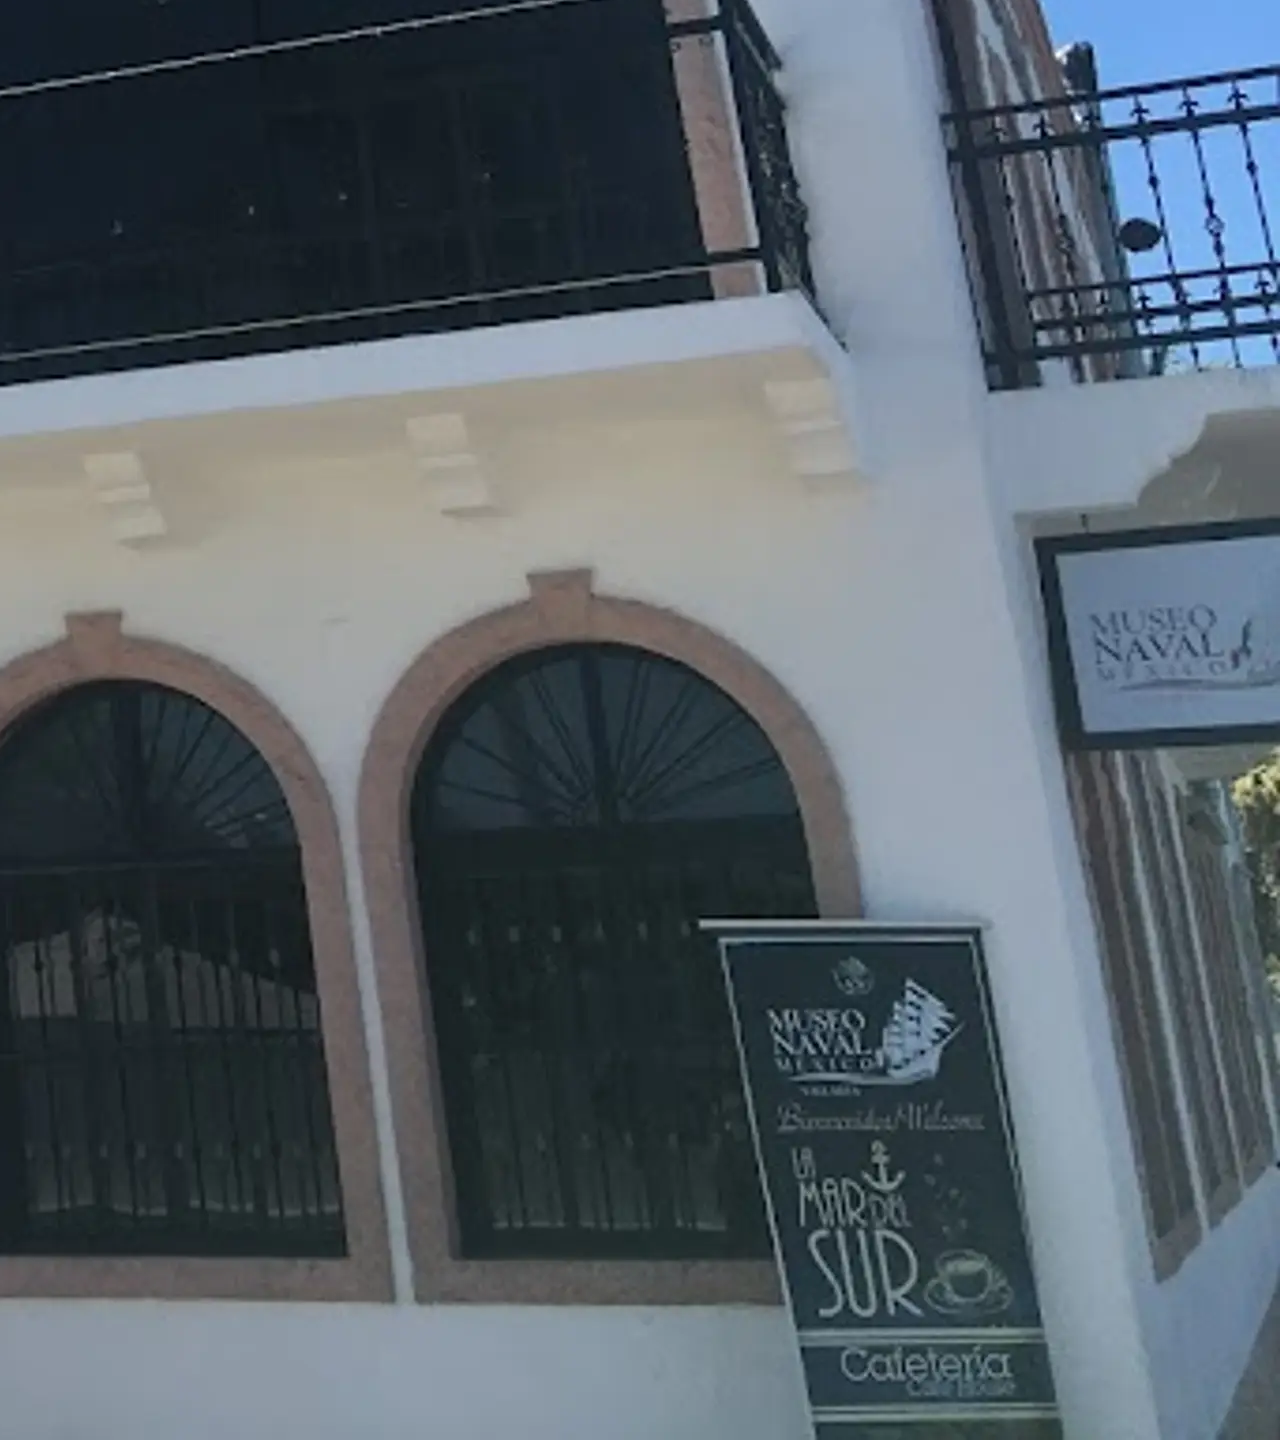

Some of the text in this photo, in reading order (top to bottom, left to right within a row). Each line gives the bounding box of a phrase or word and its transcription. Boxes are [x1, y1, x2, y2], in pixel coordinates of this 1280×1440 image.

[1088, 603, 1218, 636] MUSEO
[1093, 628, 1225, 665] NAVAL
[765, 1007, 866, 1033] MUSEO
[770, 1029, 873, 1056] NAVAL
[798, 1177, 868, 1228] MAR
[807, 1229, 925, 1319] SUR
